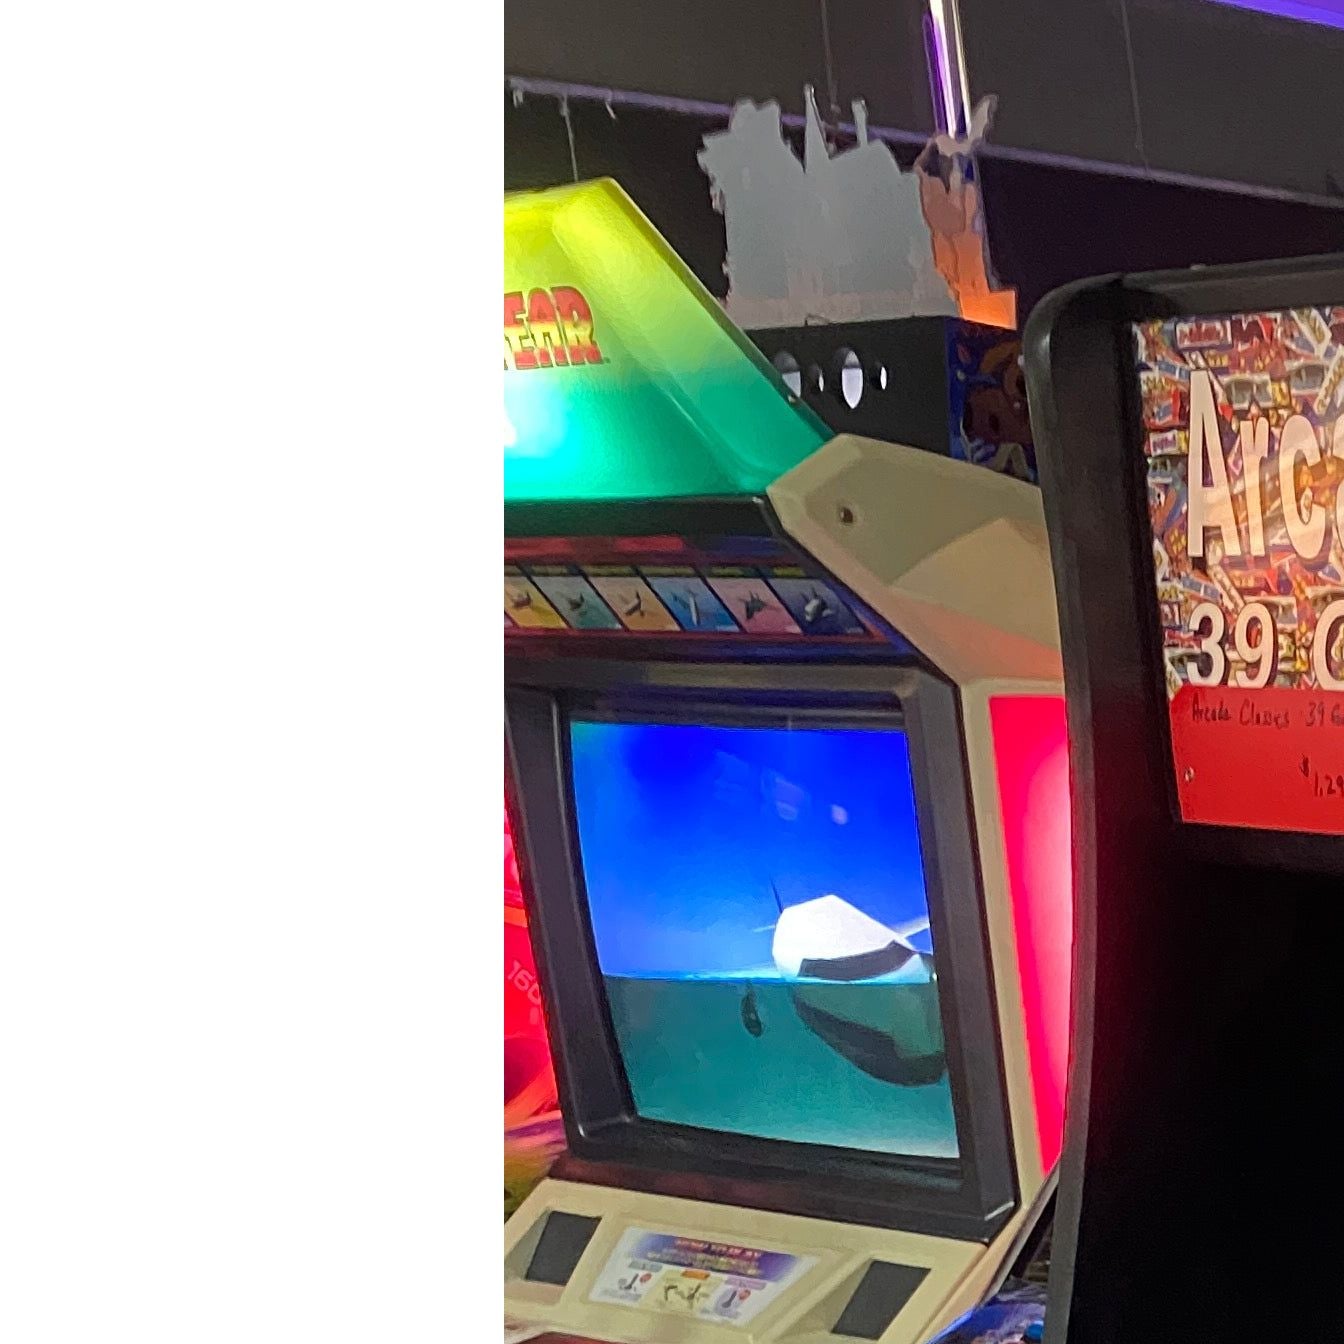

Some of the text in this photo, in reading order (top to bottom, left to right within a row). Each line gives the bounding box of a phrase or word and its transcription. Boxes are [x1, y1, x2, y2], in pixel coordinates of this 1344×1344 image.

[504, 286, 604, 370] EAR
[1187, 602, 1279, 688] 39
[1305, 702, 1325, 727] 39
